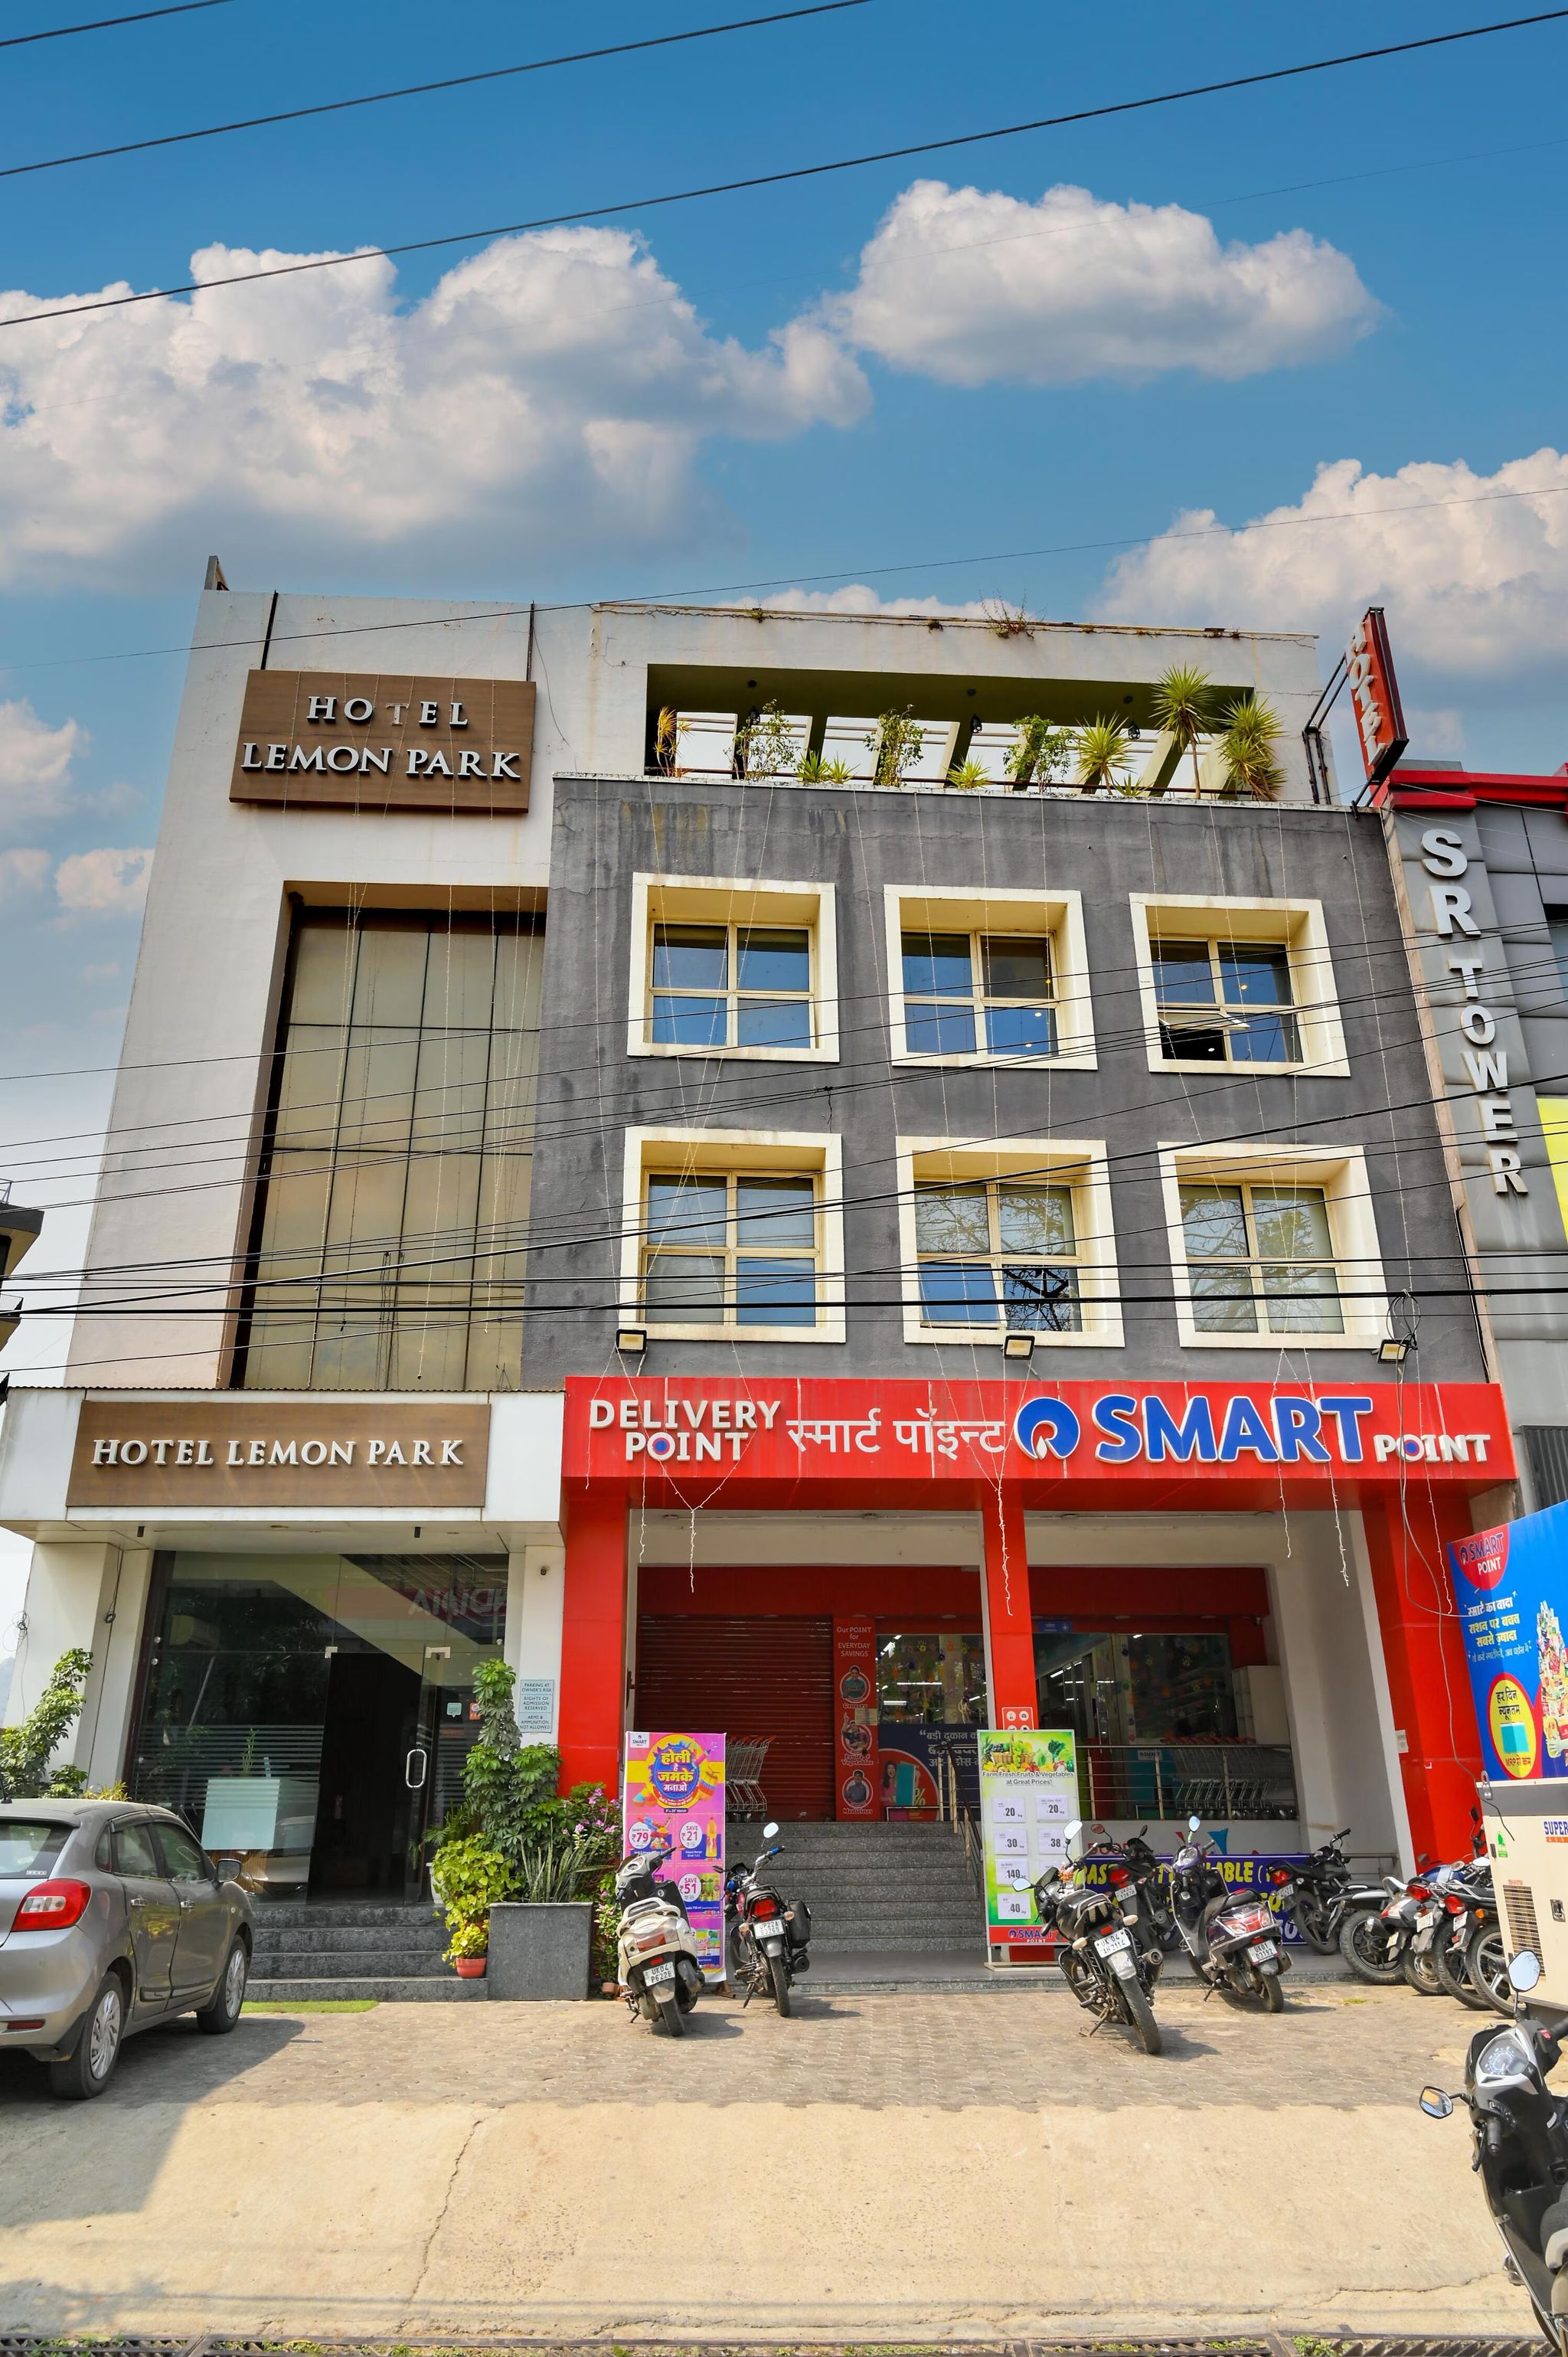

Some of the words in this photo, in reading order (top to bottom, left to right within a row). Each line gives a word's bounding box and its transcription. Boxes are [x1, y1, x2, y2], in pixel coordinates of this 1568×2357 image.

[306, 695, 469, 727] HOTEL
[240, 742, 393, 774] LEMON
[406, 749, 521, 780] PARK
[1448, 959, 1529, 1195] TOWER
[590, 1399, 781, 1430] DELIVERY
[786, 1407, 882, 1453] स्मार्ट
[893, 1407, 1006, 1460] पॉइन्ट
[1093, 1394, 1373, 1464] SMART
[1374, 1433, 1491, 1463] POINT
[90, 1439, 214, 1466] HOTEL
[225, 1440, 356, 1466] LEMON
[367, 1440, 464, 1466] PARK
[626, 1431, 749, 1461] POINT
[1468, 1532, 1504, 1561] SMART
[1477, 1557, 1501, 1575] POINT
[1496, 1691, 1505, 1704] हर
[1504, 1686, 1517, 1702] दिन
[1498, 1705, 1521, 1721] न्यूनतम
[662, 1748, 691, 1764] होली
[657, 1767, 694, 1782] जमके
[664, 1781, 688, 1791] मनाओ
[1005, 1807, 1015, 1816] 20
[1048, 1804, 1059, 1813] 20
[1007, 1839, 1018, 1848] 30
[1050, 1838, 1061, 1848] 38
[1007, 1868, 1021, 1878] 140
[1010, 1903, 1021, 1913] 40
[1254, 1943, 1269, 1953] UK01
